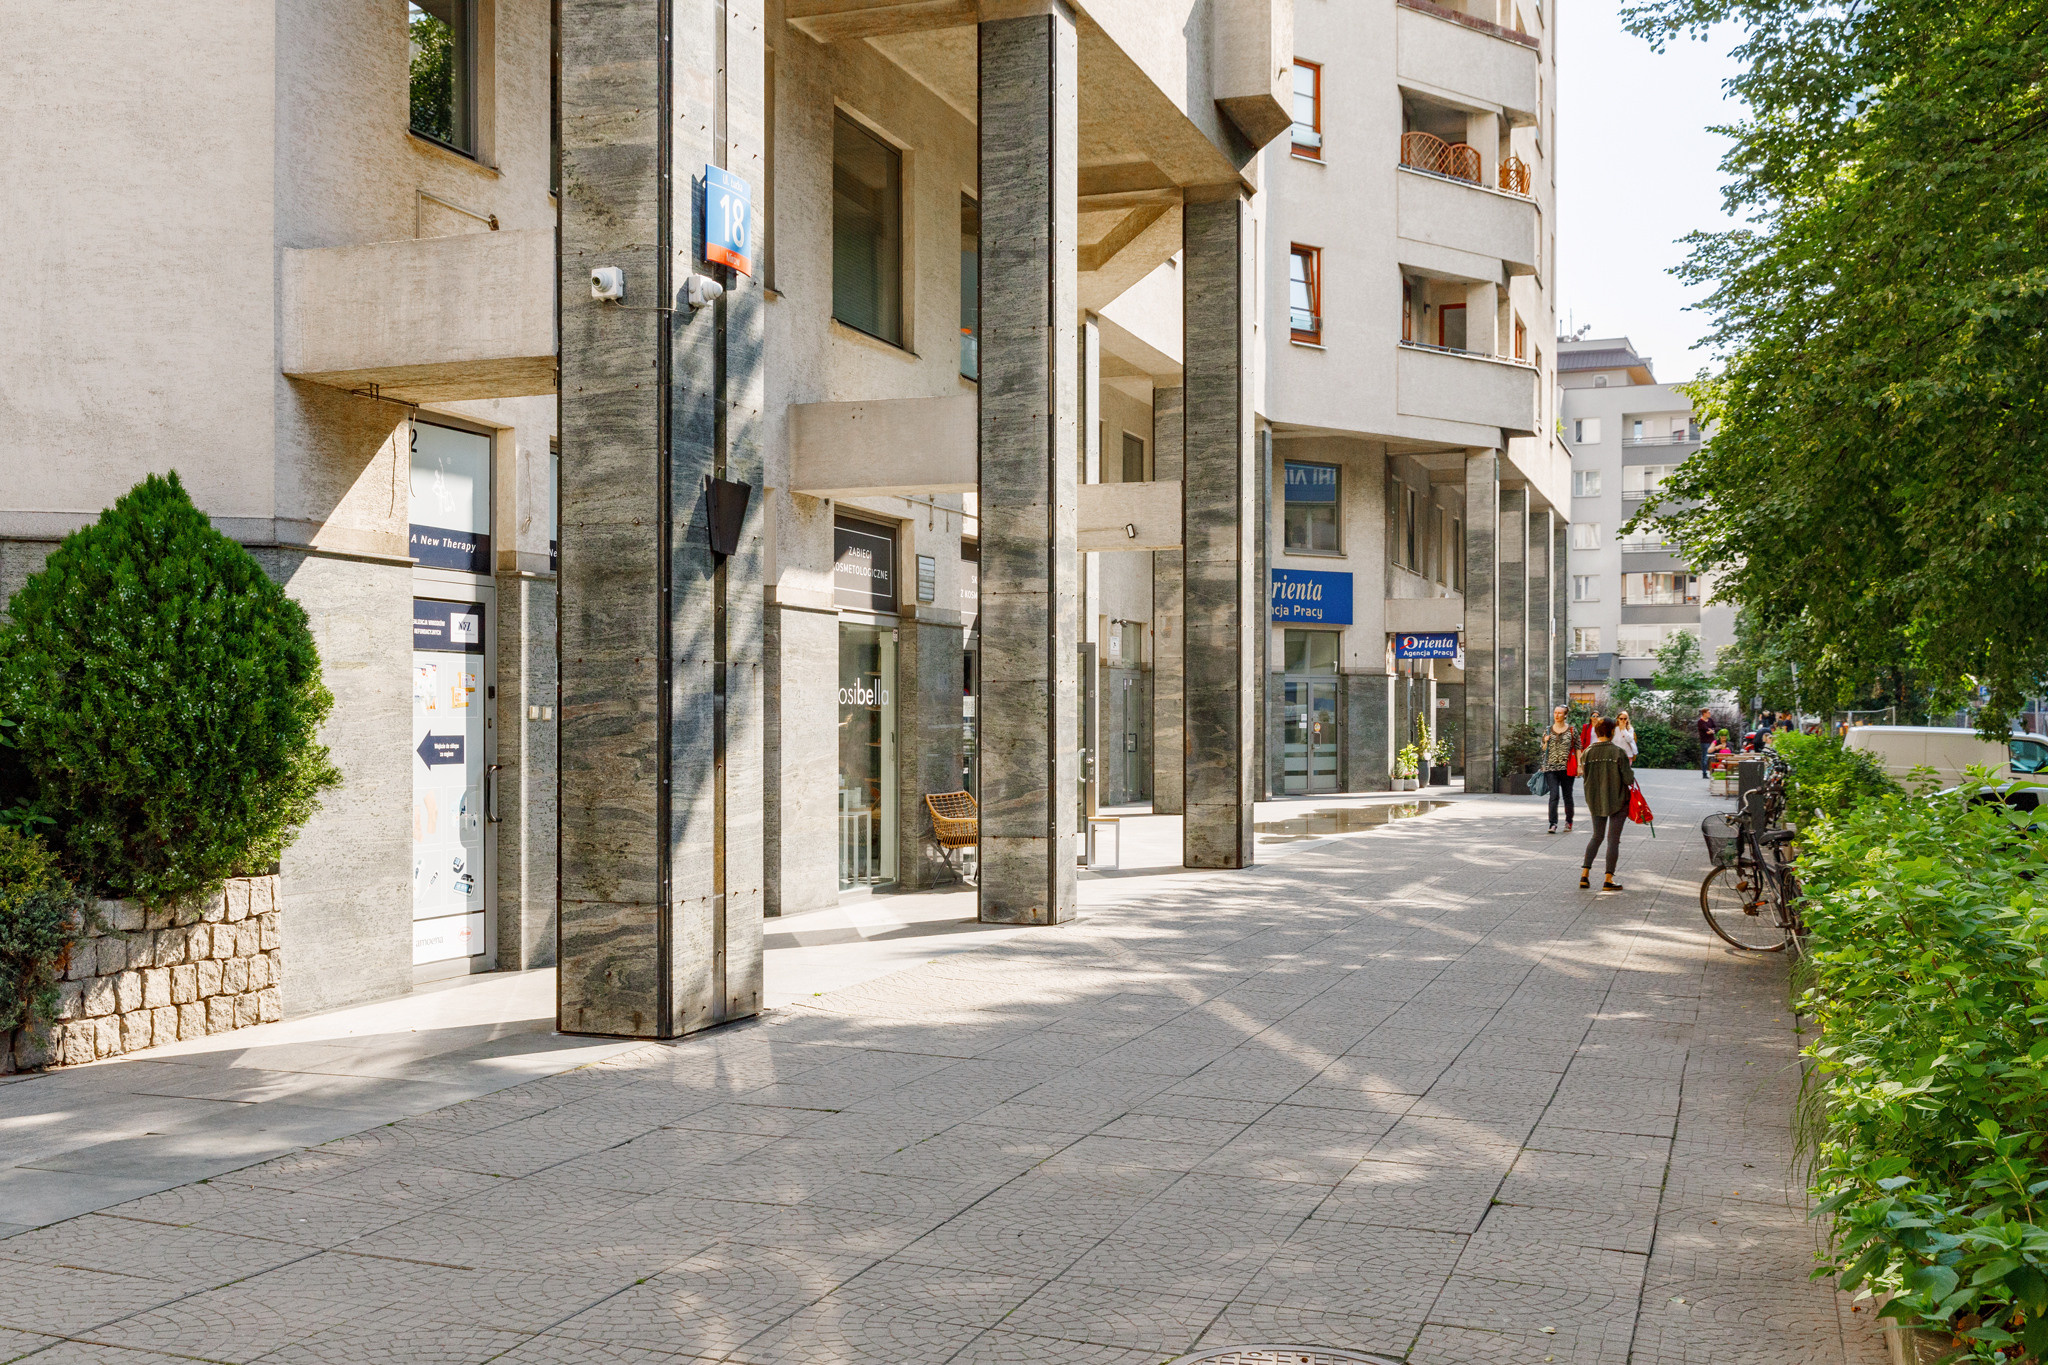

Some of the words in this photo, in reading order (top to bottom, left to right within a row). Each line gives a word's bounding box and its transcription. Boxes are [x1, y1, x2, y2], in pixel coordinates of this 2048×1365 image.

[720, 194, 745, 248] 18
[410, 534, 418, 544] A
[420, 535, 440, 547] New
[442, 538, 477, 554] Therapy
[848, 546, 872, 560] ZABIEGI
[1271, 574, 1323, 601] rienta
[1293, 604, 1323, 620] Pracy
[1402, 635, 1454, 650] Orienta
[1403, 650, 1431, 658] Agencja
[1433, 650, 1454, 658] Pracy
[1333, 660, 1338, 673] 7
[838, 677, 889, 706] osibella
